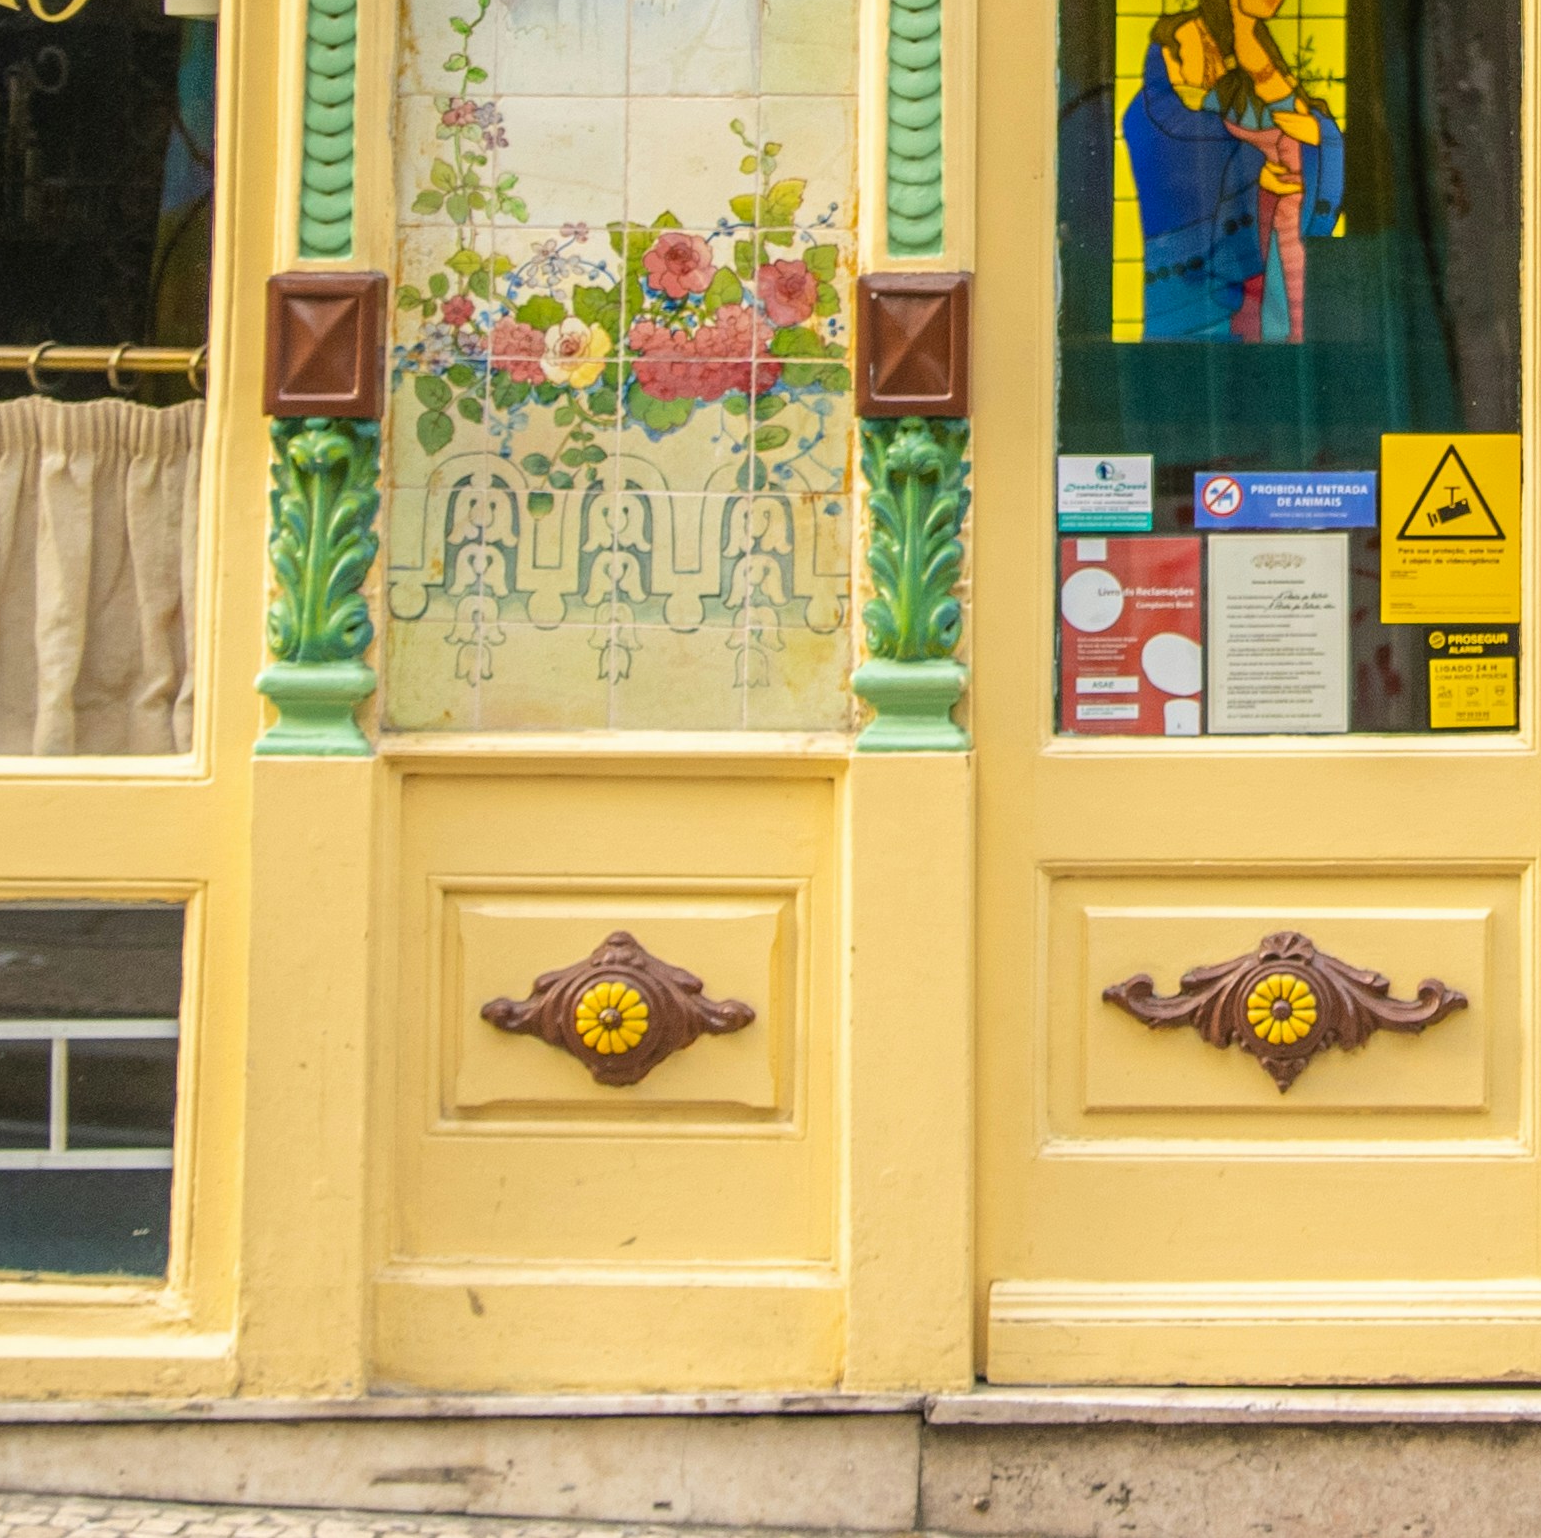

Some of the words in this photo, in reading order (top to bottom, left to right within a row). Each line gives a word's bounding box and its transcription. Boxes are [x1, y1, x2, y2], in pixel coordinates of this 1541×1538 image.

[1250, 484, 1303, 494] PROIBIDA
[1305, 484, 1314, 494] A
[1316, 484, 1368, 495] ENTRADA
[1277, 497, 1293, 507] DE
[1294, 497, 1342, 507] ANIMAIS
[1098, 588, 1120, 597] Livro
[1447, 633, 1509, 645] PROSEGUR
[1435, 665, 1473, 673] LIGADO
[1476, 664, 1487, 672] 24
[1490, 664, 1498, 672] H
